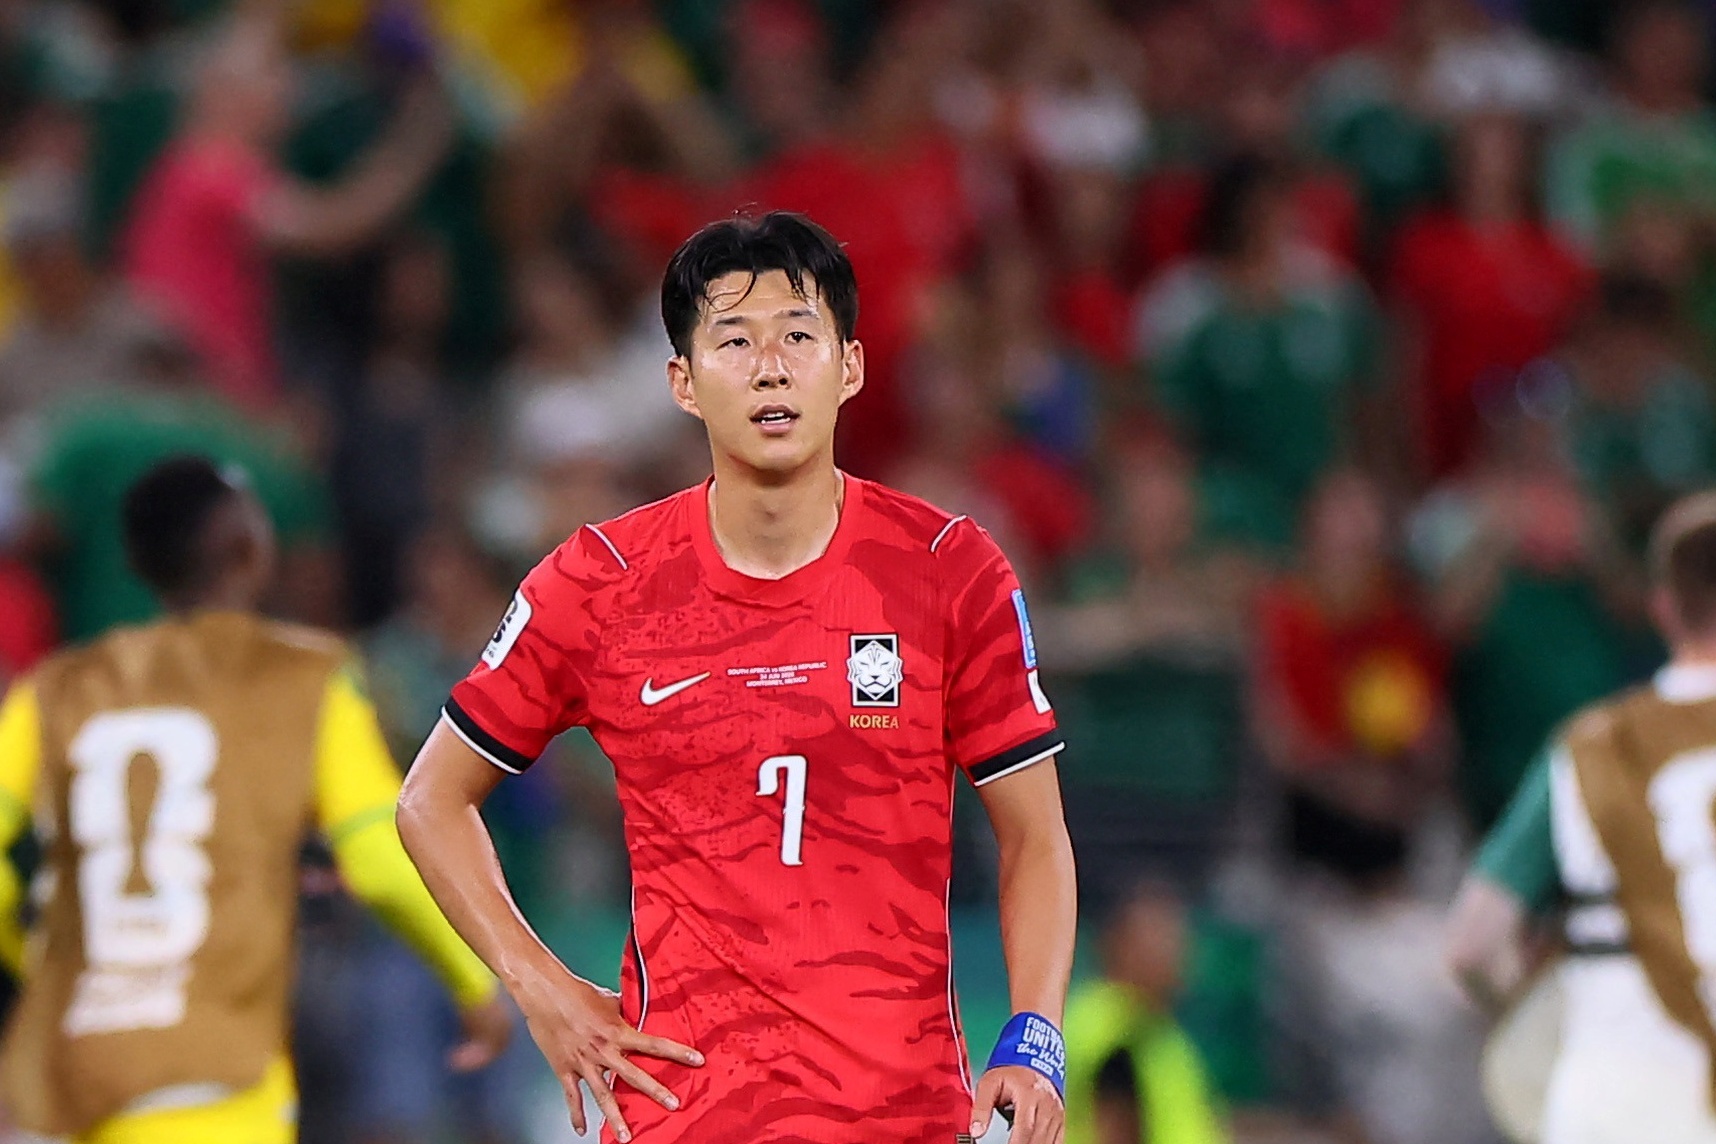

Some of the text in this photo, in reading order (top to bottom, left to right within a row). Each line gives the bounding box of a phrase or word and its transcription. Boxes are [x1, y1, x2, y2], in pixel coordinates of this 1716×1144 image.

[849, 714, 899, 729] KOREA
[755, 754, 807, 866] 7
[1026, 1016, 1061, 1041] FOOTB
[1016, 1043, 1038, 1055] the
